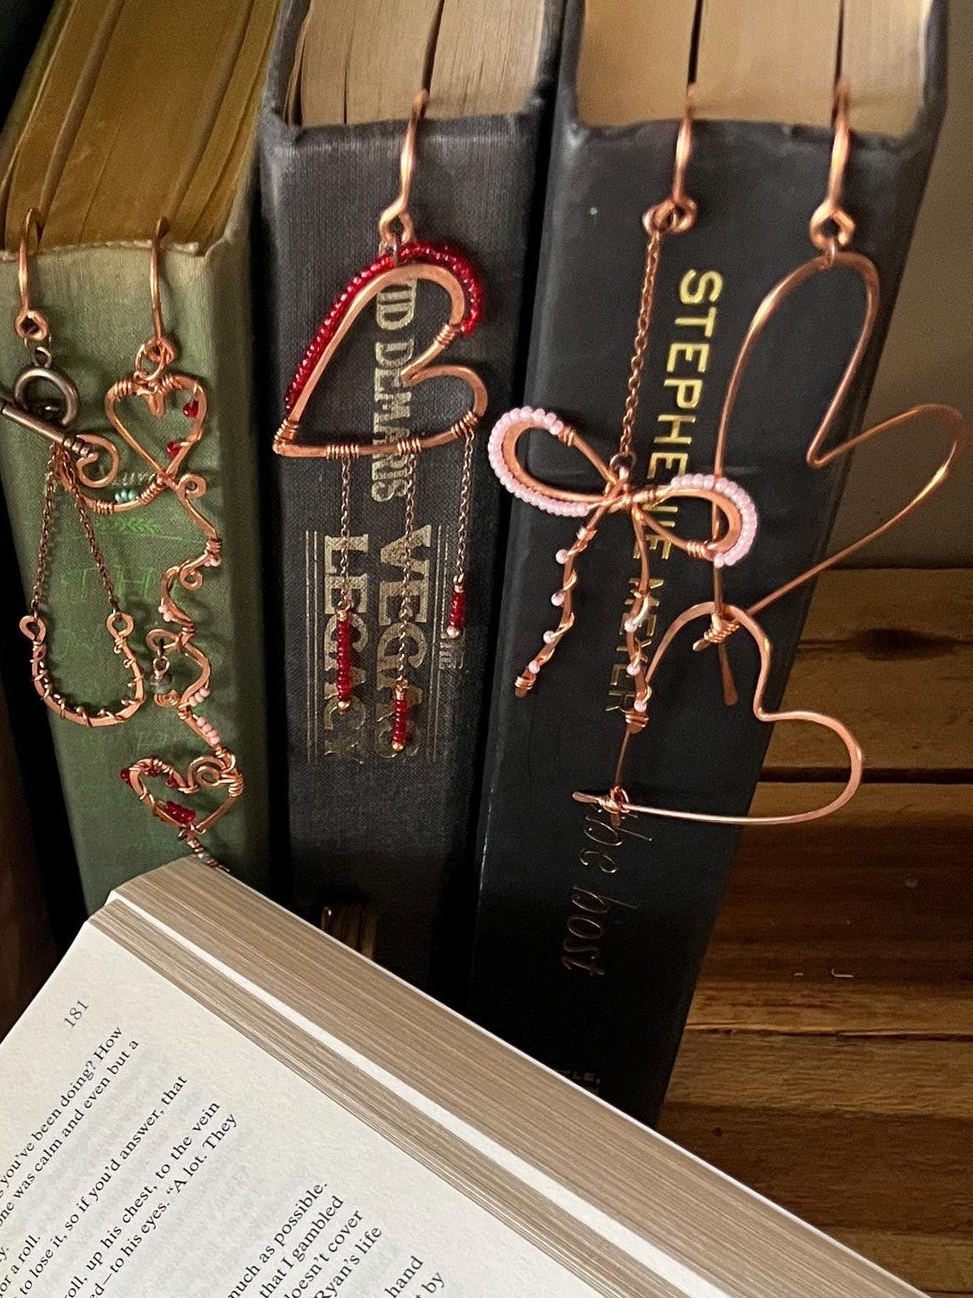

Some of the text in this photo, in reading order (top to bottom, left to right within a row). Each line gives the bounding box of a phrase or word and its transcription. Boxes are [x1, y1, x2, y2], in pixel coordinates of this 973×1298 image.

[63, 999, 89, 1028] 181
[258, 1244, 276, 1264] as
[272, 1182, 328, 1248] possible.
[383, 1254, 424, 1298] hand
